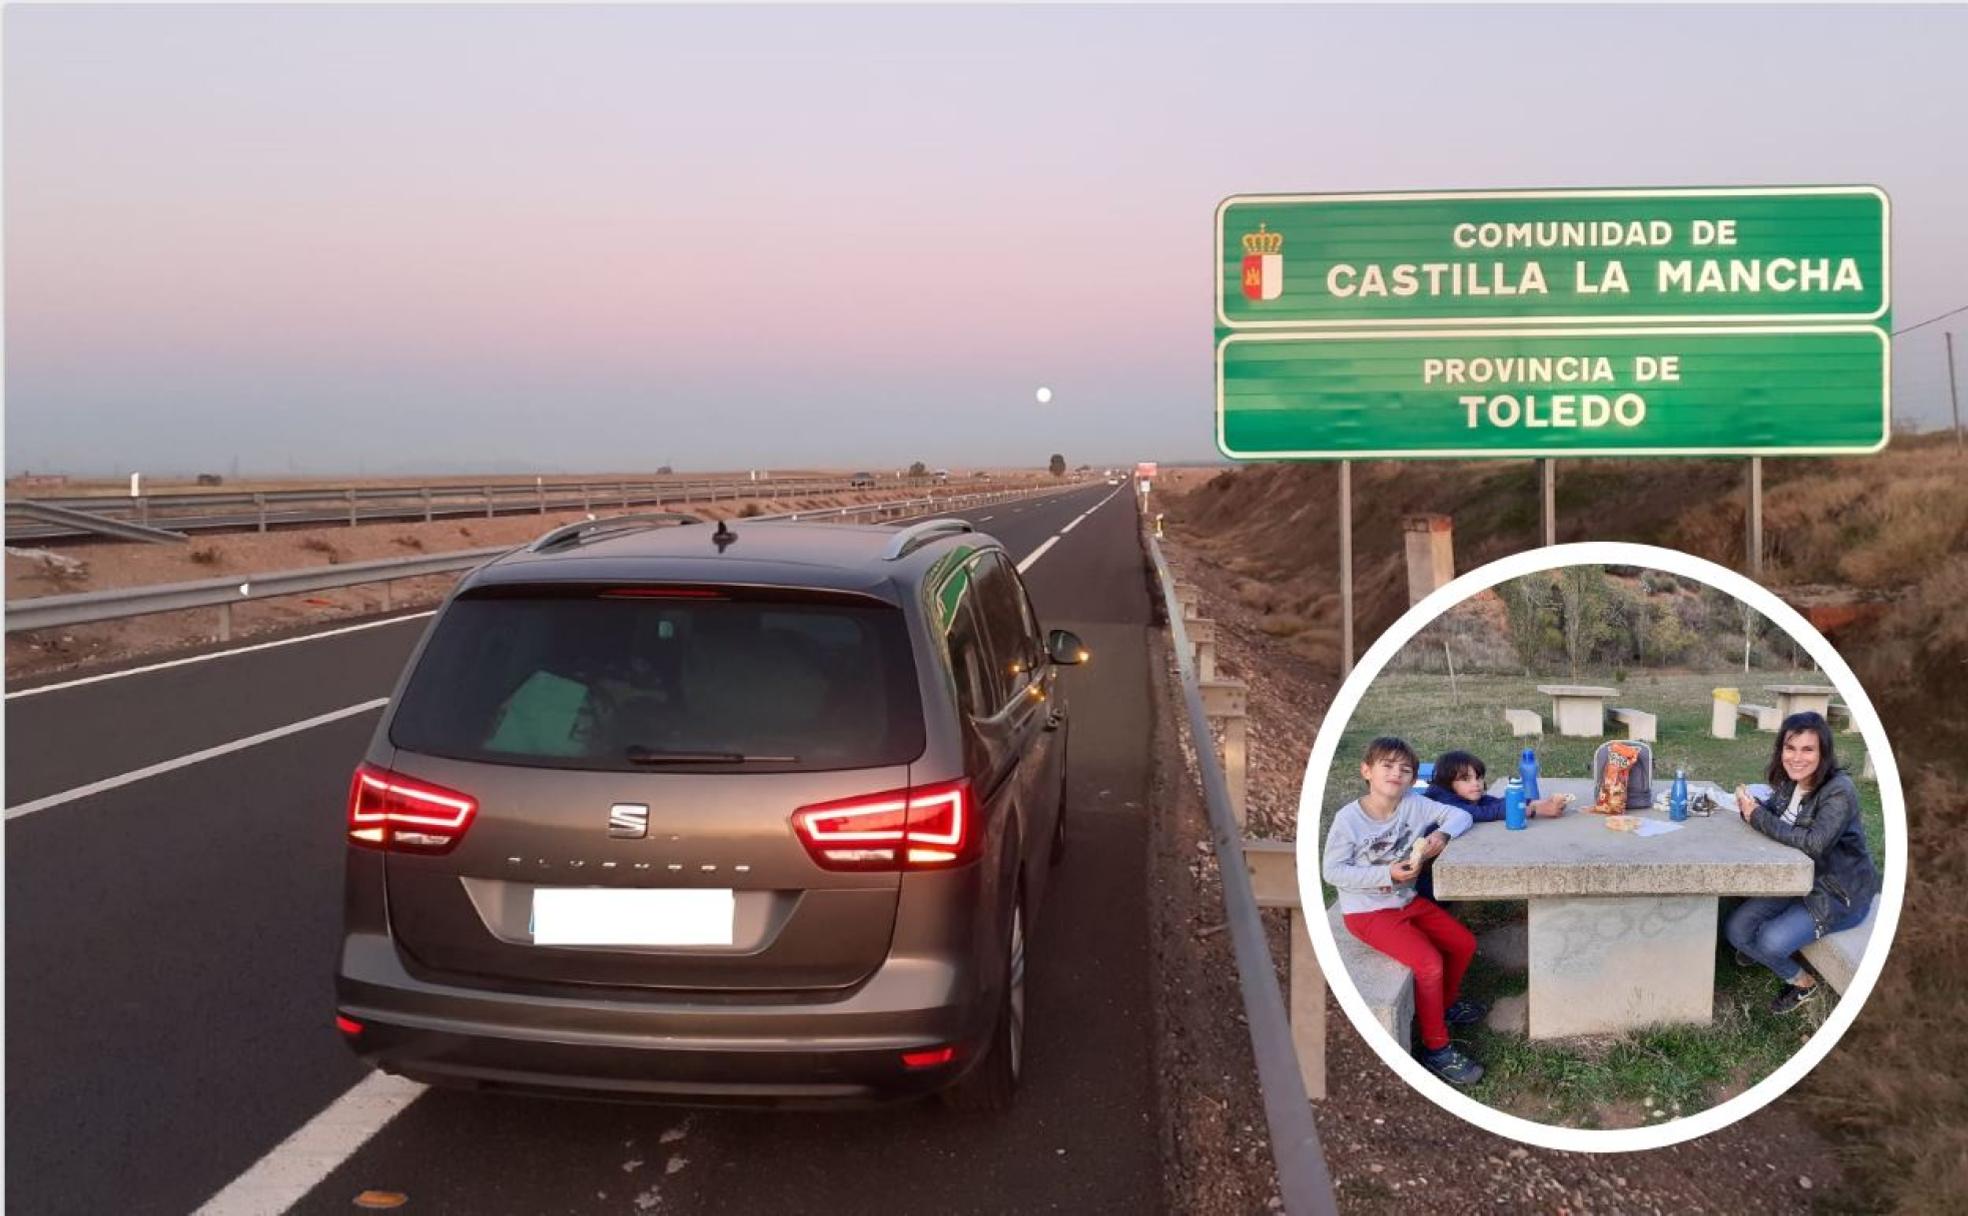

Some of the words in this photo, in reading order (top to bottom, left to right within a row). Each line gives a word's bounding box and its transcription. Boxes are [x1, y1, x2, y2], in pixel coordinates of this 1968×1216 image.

[1454, 221, 1673, 249] COMUNIDAD
[1692, 220, 1738, 246] DE
[1326, 262, 1549, 299] CASTILLA
[1576, 261, 1631, 295] LA
[1659, 258, 1864, 294] MANCHA
[1424, 357, 1615, 384] PROVINCIA
[1636, 356, 1681, 383] DE
[1460, 394, 1647, 429] TOLEDO
